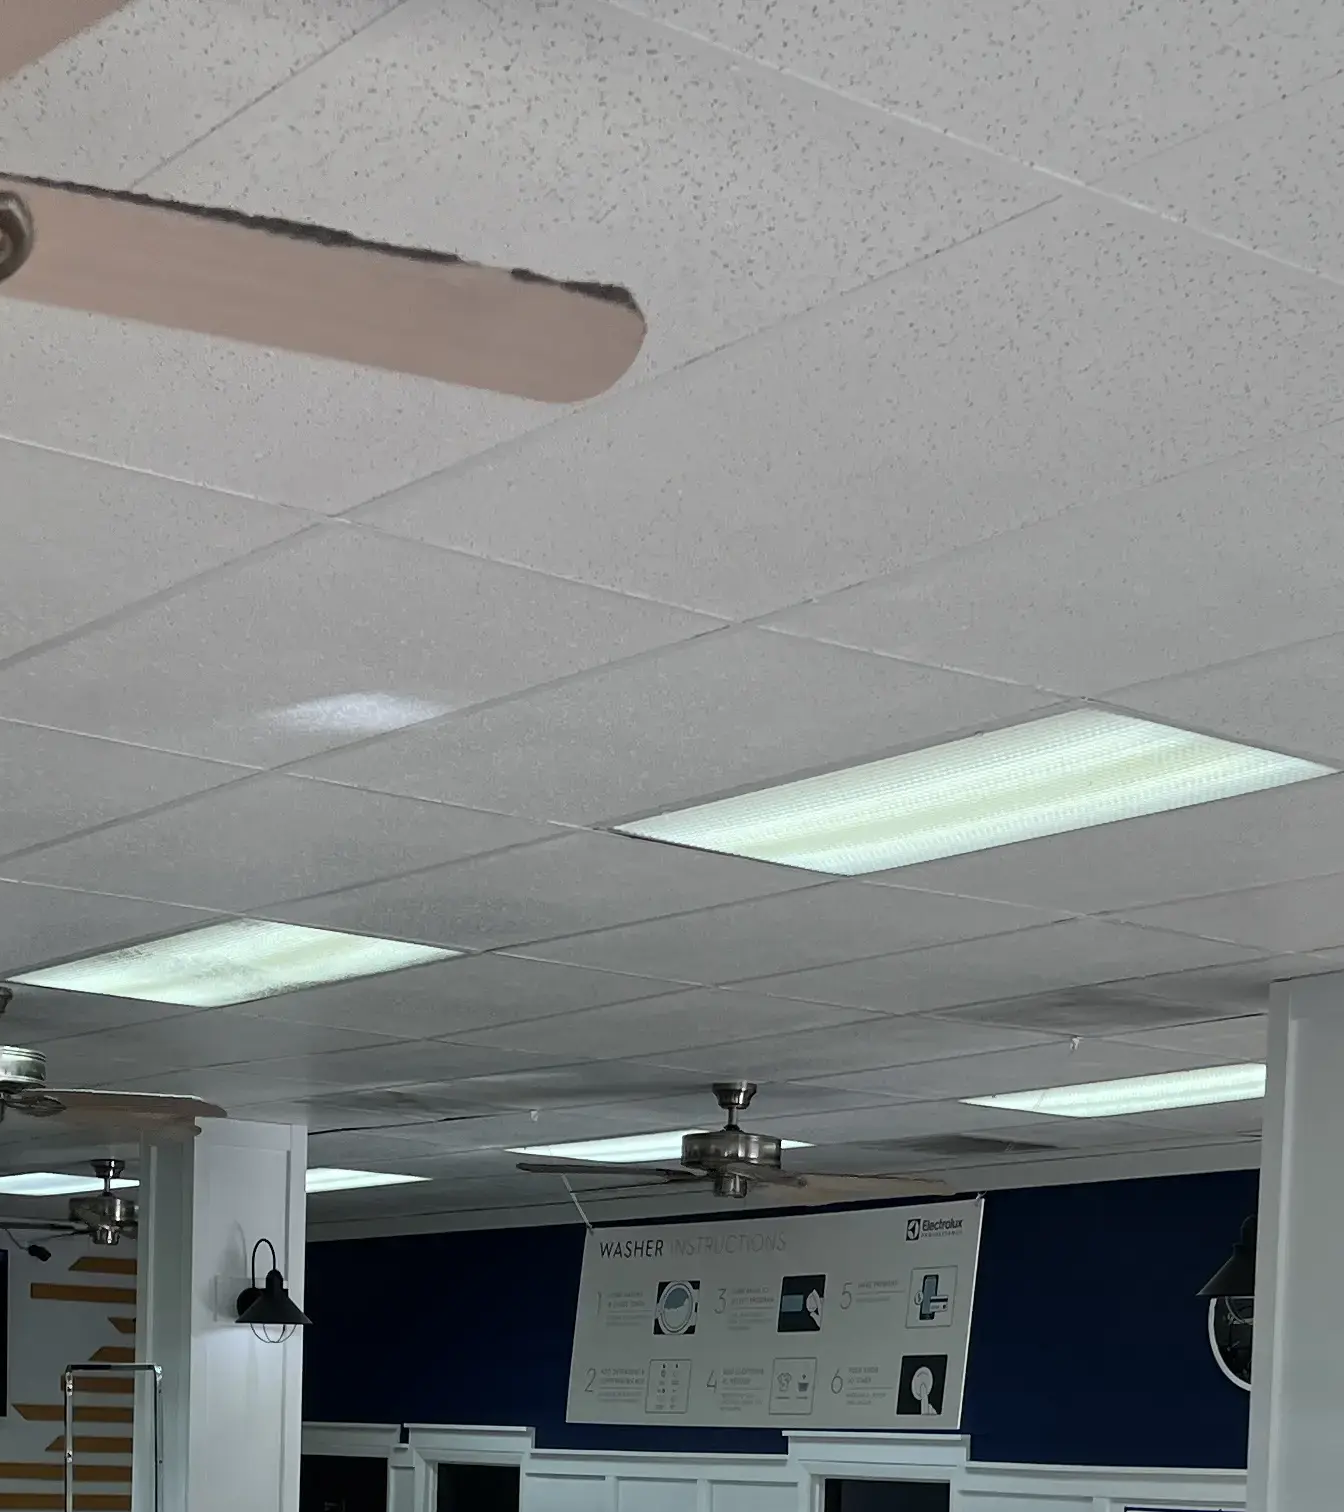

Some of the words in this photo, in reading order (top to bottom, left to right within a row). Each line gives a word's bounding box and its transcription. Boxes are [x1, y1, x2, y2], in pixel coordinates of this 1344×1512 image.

[922, 1218, 963, 1231] Electrolux
[599, 1239, 664, 1258] WASHER
[670, 1232, 786, 1256] INSTRUCTIONS
[714, 1288, 727, 1315] 3
[840, 1281, 853, 1310] 5
[584, 1367, 597, 1393] 2
[706, 1369, 717, 1393] 4
[831, 1367, 843, 1394] 6
